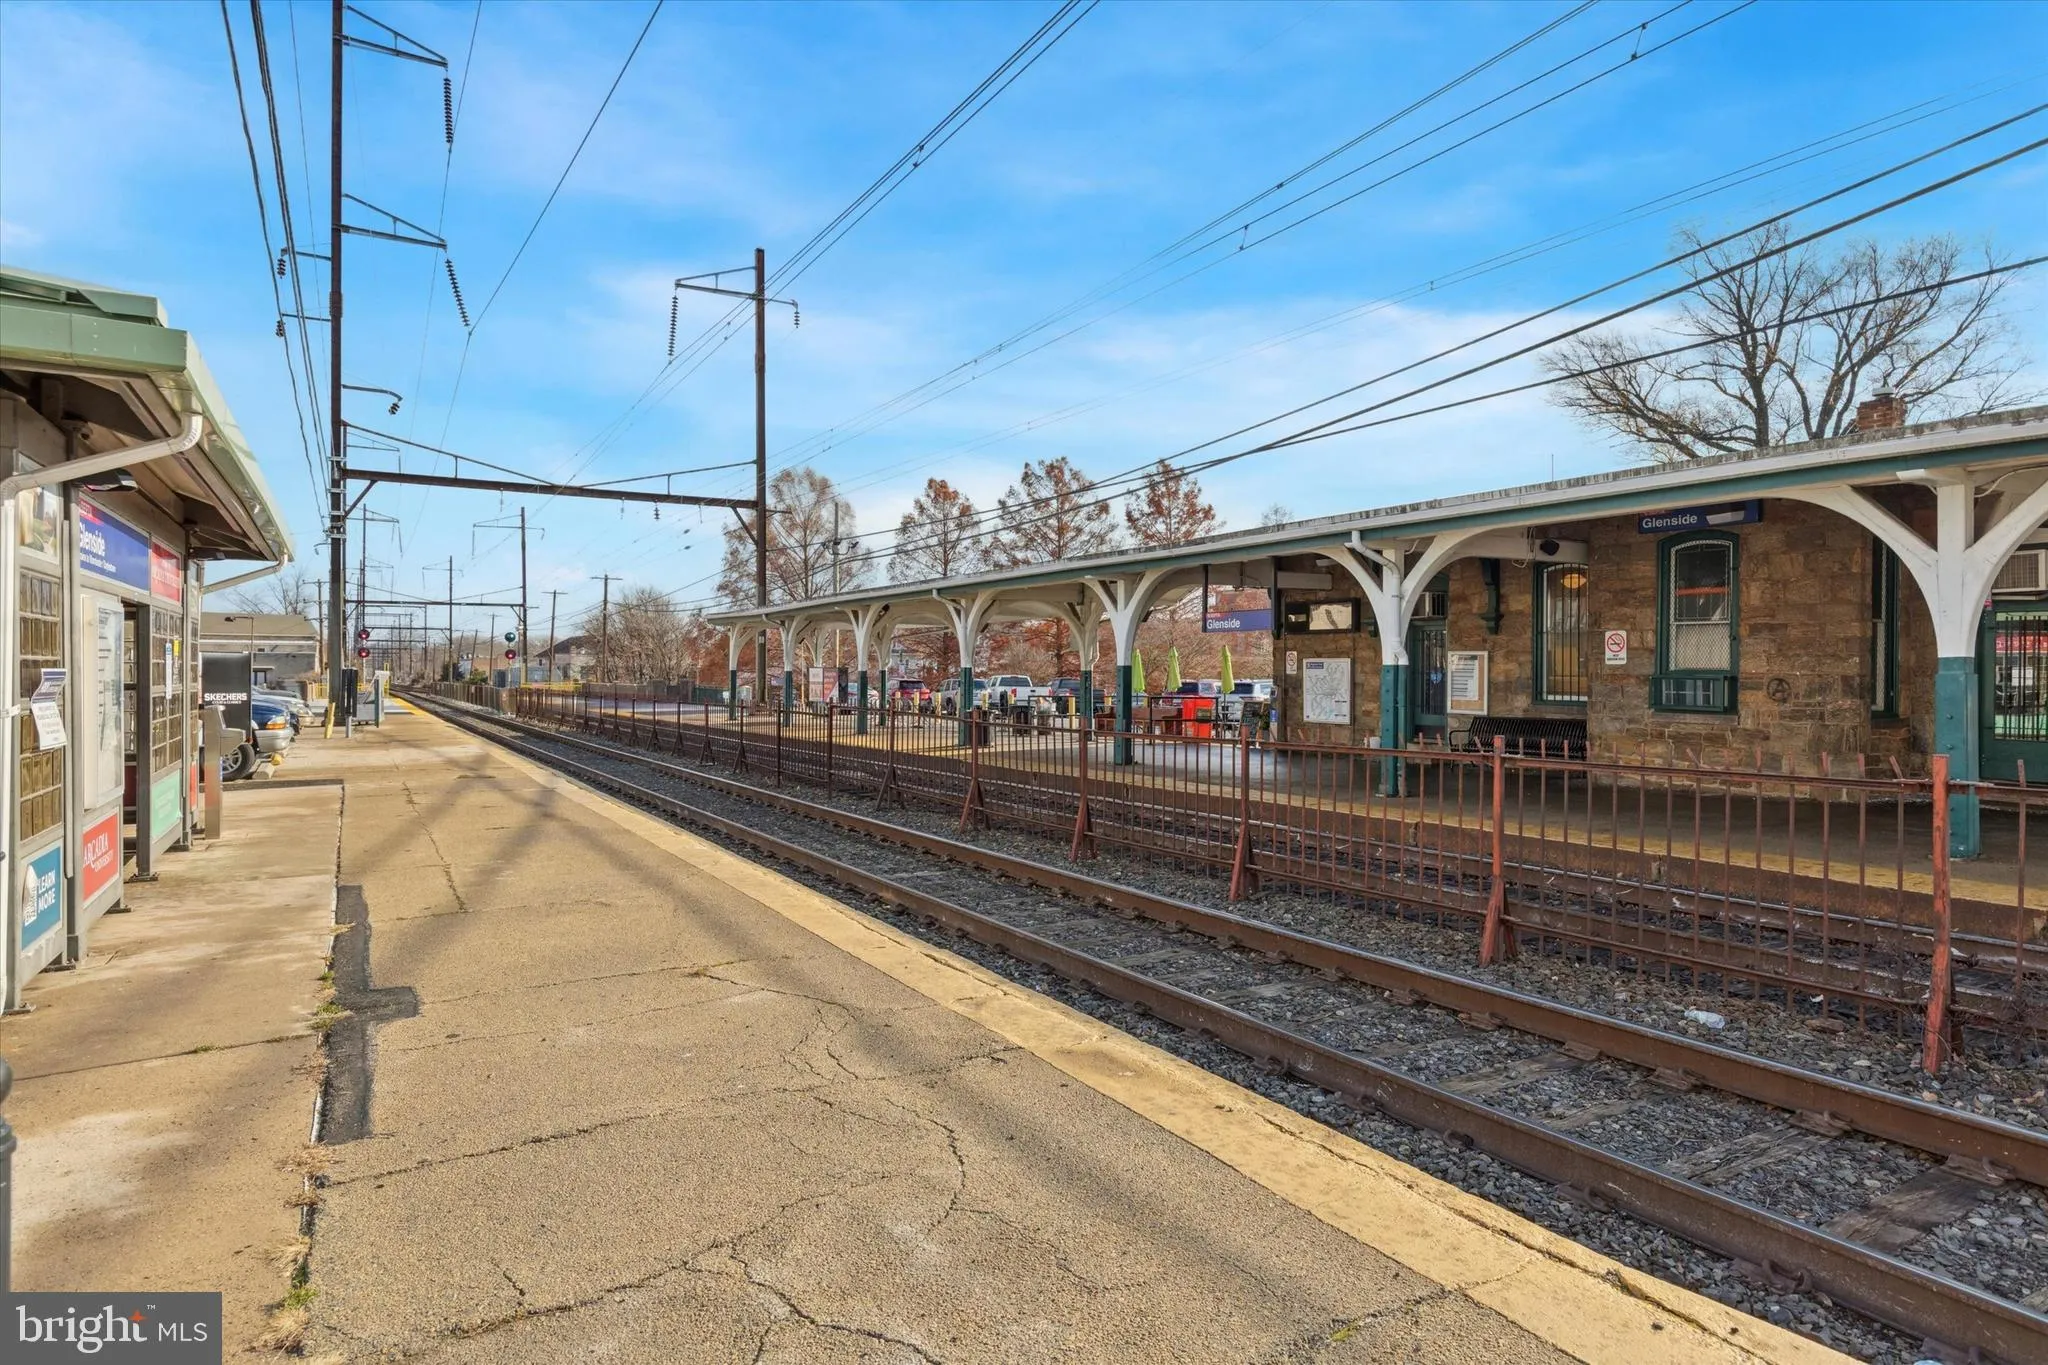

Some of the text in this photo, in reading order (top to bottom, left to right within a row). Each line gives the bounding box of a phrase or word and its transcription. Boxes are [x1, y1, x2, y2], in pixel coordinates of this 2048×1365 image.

[1643, 514, 1697, 528] Glenside
[1207, 618, 1241, 629] Glenside
[204, 693, 248, 701] SKECHERS
[38, 868, 56, 894] LEARN
[37, 887, 56, 914] MORE
